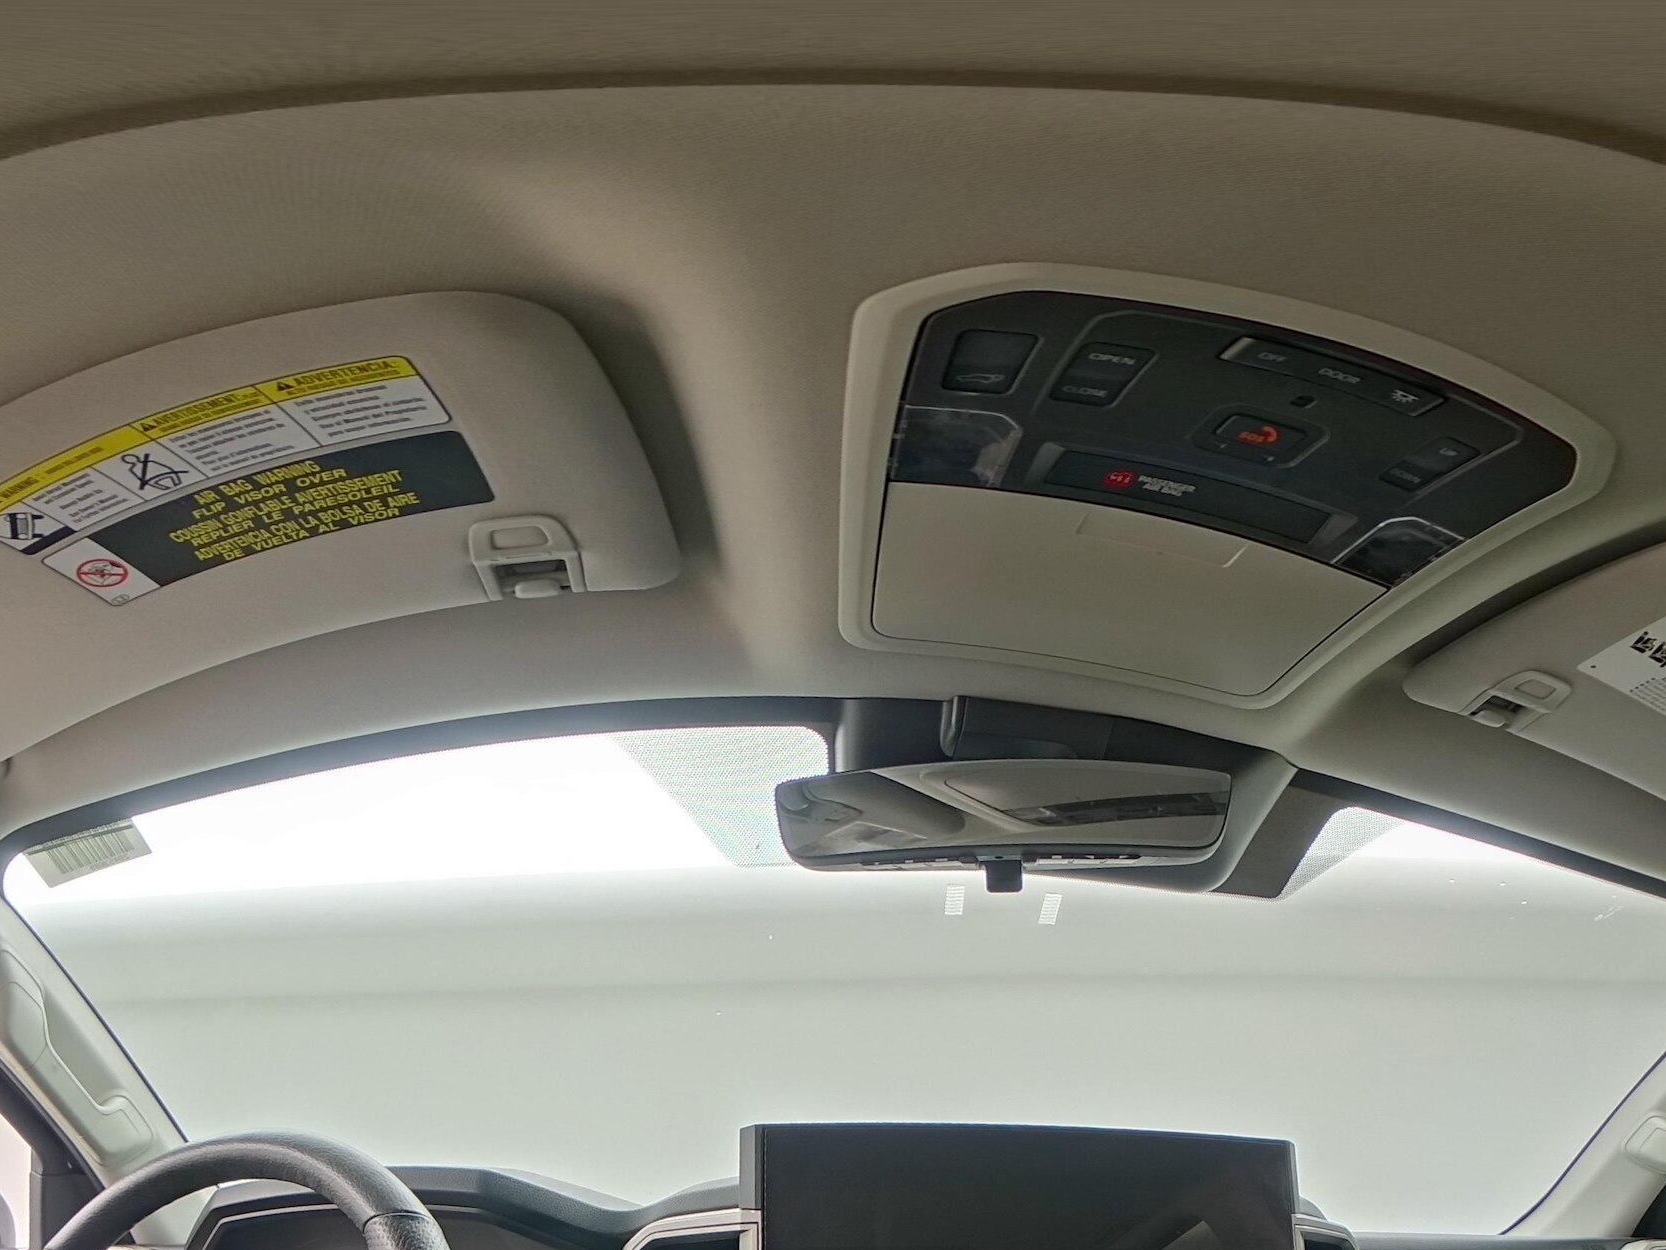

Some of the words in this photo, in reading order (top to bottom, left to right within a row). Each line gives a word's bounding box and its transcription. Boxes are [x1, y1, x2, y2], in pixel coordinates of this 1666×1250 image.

[1088, 352, 1136, 366] OPEN
[1258, 351, 1288, 363] OFF
[1317, 367, 1361, 385] DOOR
[1062, 385, 1110, 398] CLOSE
[1237, 430, 1265, 444] SOS
[192, 501, 227, 520] FLIP
[233, 484, 287, 504] VISOR
[296, 468, 348, 487] OVER
[193, 489, 219, 505] AIR
[221, 479, 253, 497] BAG
[253, 460, 322, 486] WARNING
[169, 518, 224, 543] COUSSIN
[223, 497, 296, 526] GONFLABLE
[294, 469, 403, 502] AVERTISSEMENT
[190, 520, 254, 547] REPLIER
[264, 511, 285, 524] LE
[293, 484, 401, 515] PARESOLEIL
[194, 529, 271, 561] ADVERTENCIA
[270, 520, 301, 536] CON
[300, 514, 320, 527] LA
[318, 500, 367, 522] BOLSA
[367, 497, 388, 512] DE
[387, 492, 420, 507] AIRE
[223, 549, 245, 561] DE
[253, 530, 311, 552] VUELTA
[317, 522, 340, 534] AL
[348, 507, 400, 526] VISOR
